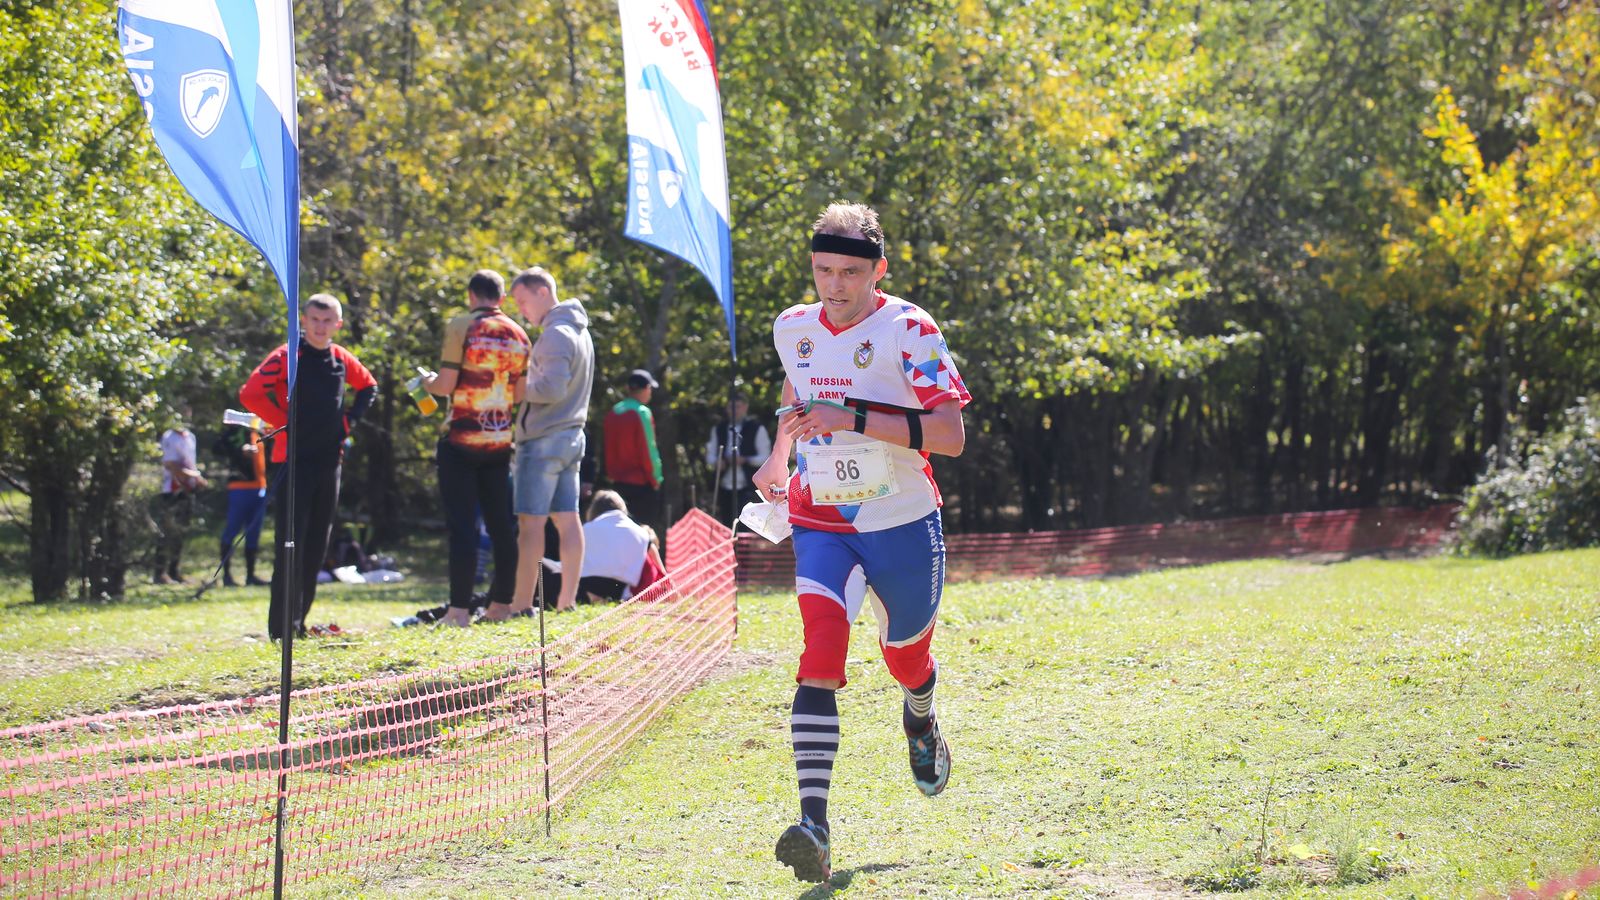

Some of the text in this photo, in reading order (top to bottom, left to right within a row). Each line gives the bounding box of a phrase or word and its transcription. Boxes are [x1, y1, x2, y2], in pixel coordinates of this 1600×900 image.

[810, 377, 852, 386] RUSSIAN
[818, 391, 846, 399] ARMY
[835, 459, 860, 481] 86
[925, 520, 940, 605] RUSSIAN ARMY
